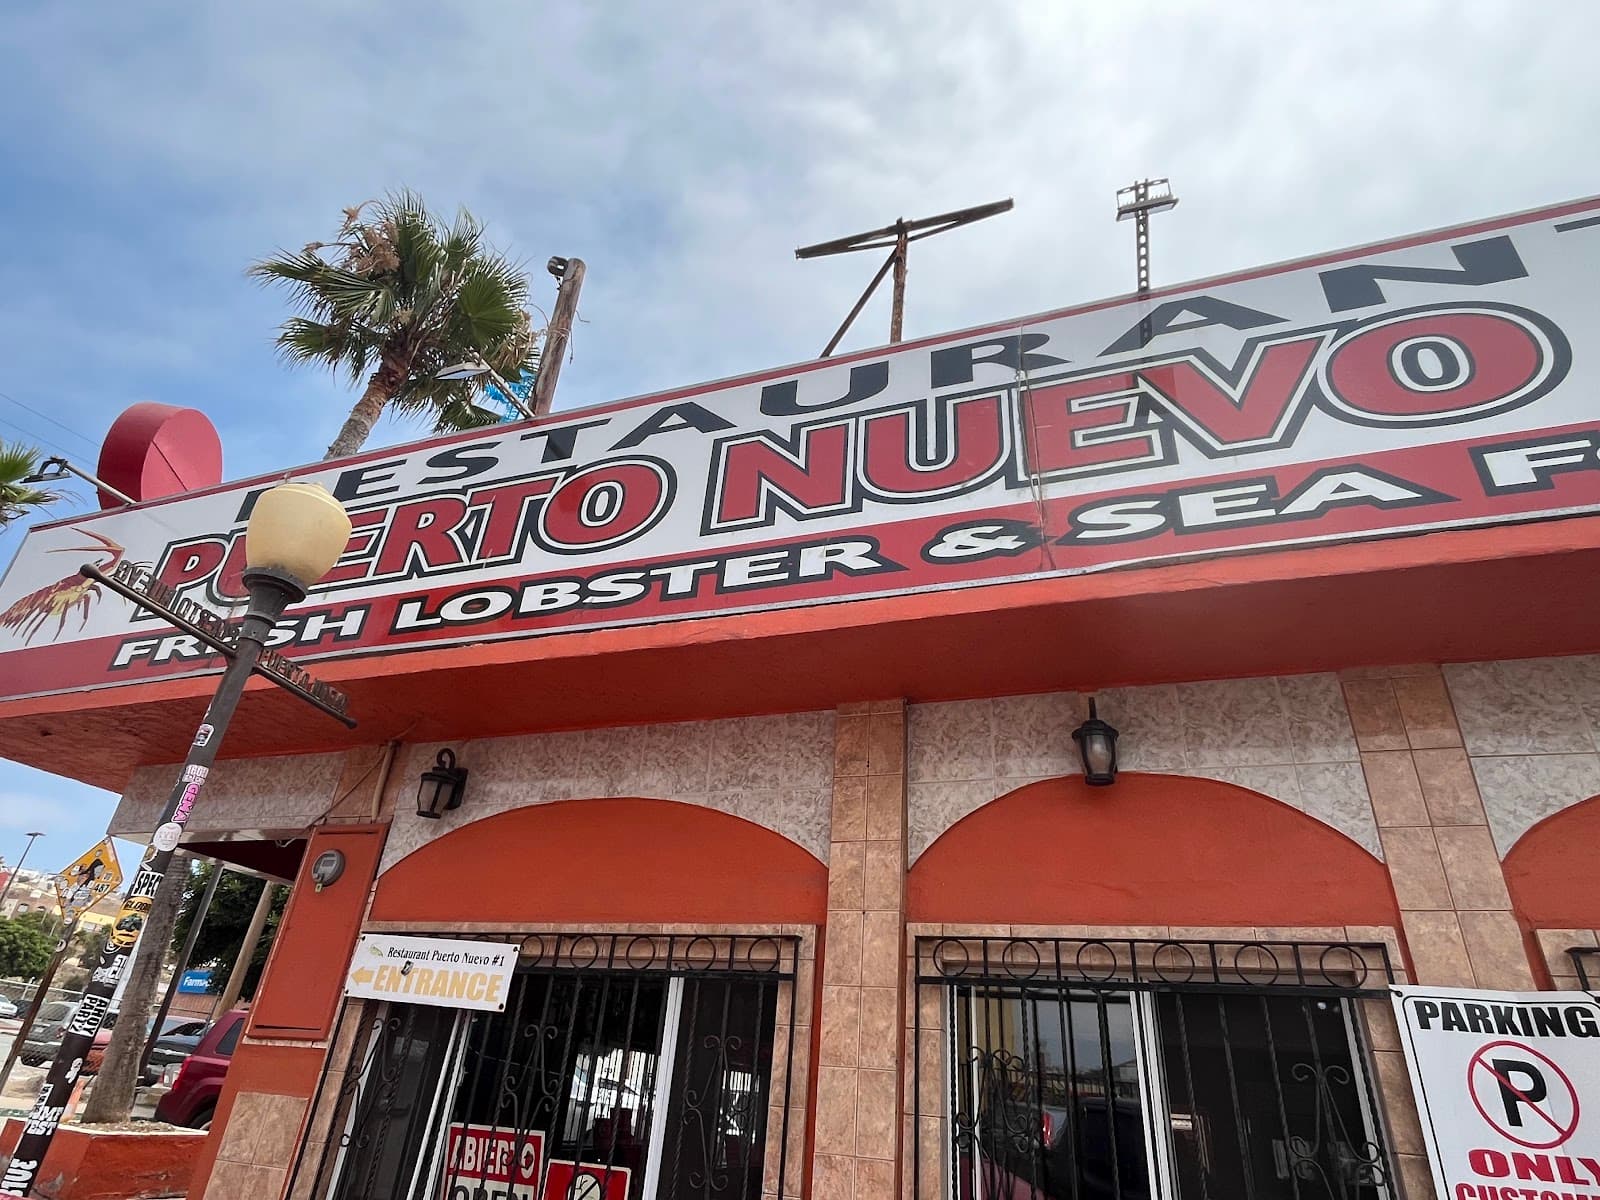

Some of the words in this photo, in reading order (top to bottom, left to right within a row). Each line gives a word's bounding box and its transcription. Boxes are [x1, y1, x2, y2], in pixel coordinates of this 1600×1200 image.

[235, 215, 1600, 522] ESTAURAN
[700, 301, 1572, 536] NUEVO
[110, 606, 370, 670] FRSH
[394, 537, 898, 633] LOBSTER
[925, 520, 1040, 562] &
[1060, 466, 1445, 543] SEA
[1477, 435, 1600, 492] F
[387, 946, 430, 961] Restaurant
[431, 949, 460, 963] Puerto
[461, 952, 490, 966] Nuevo
[491, 953, 505, 967] #1
[373, 964, 504, 1002] ENTRANCE
[1413, 1000, 1600, 1038] PARKING
[449, 1134, 536, 1179] ABIERO
